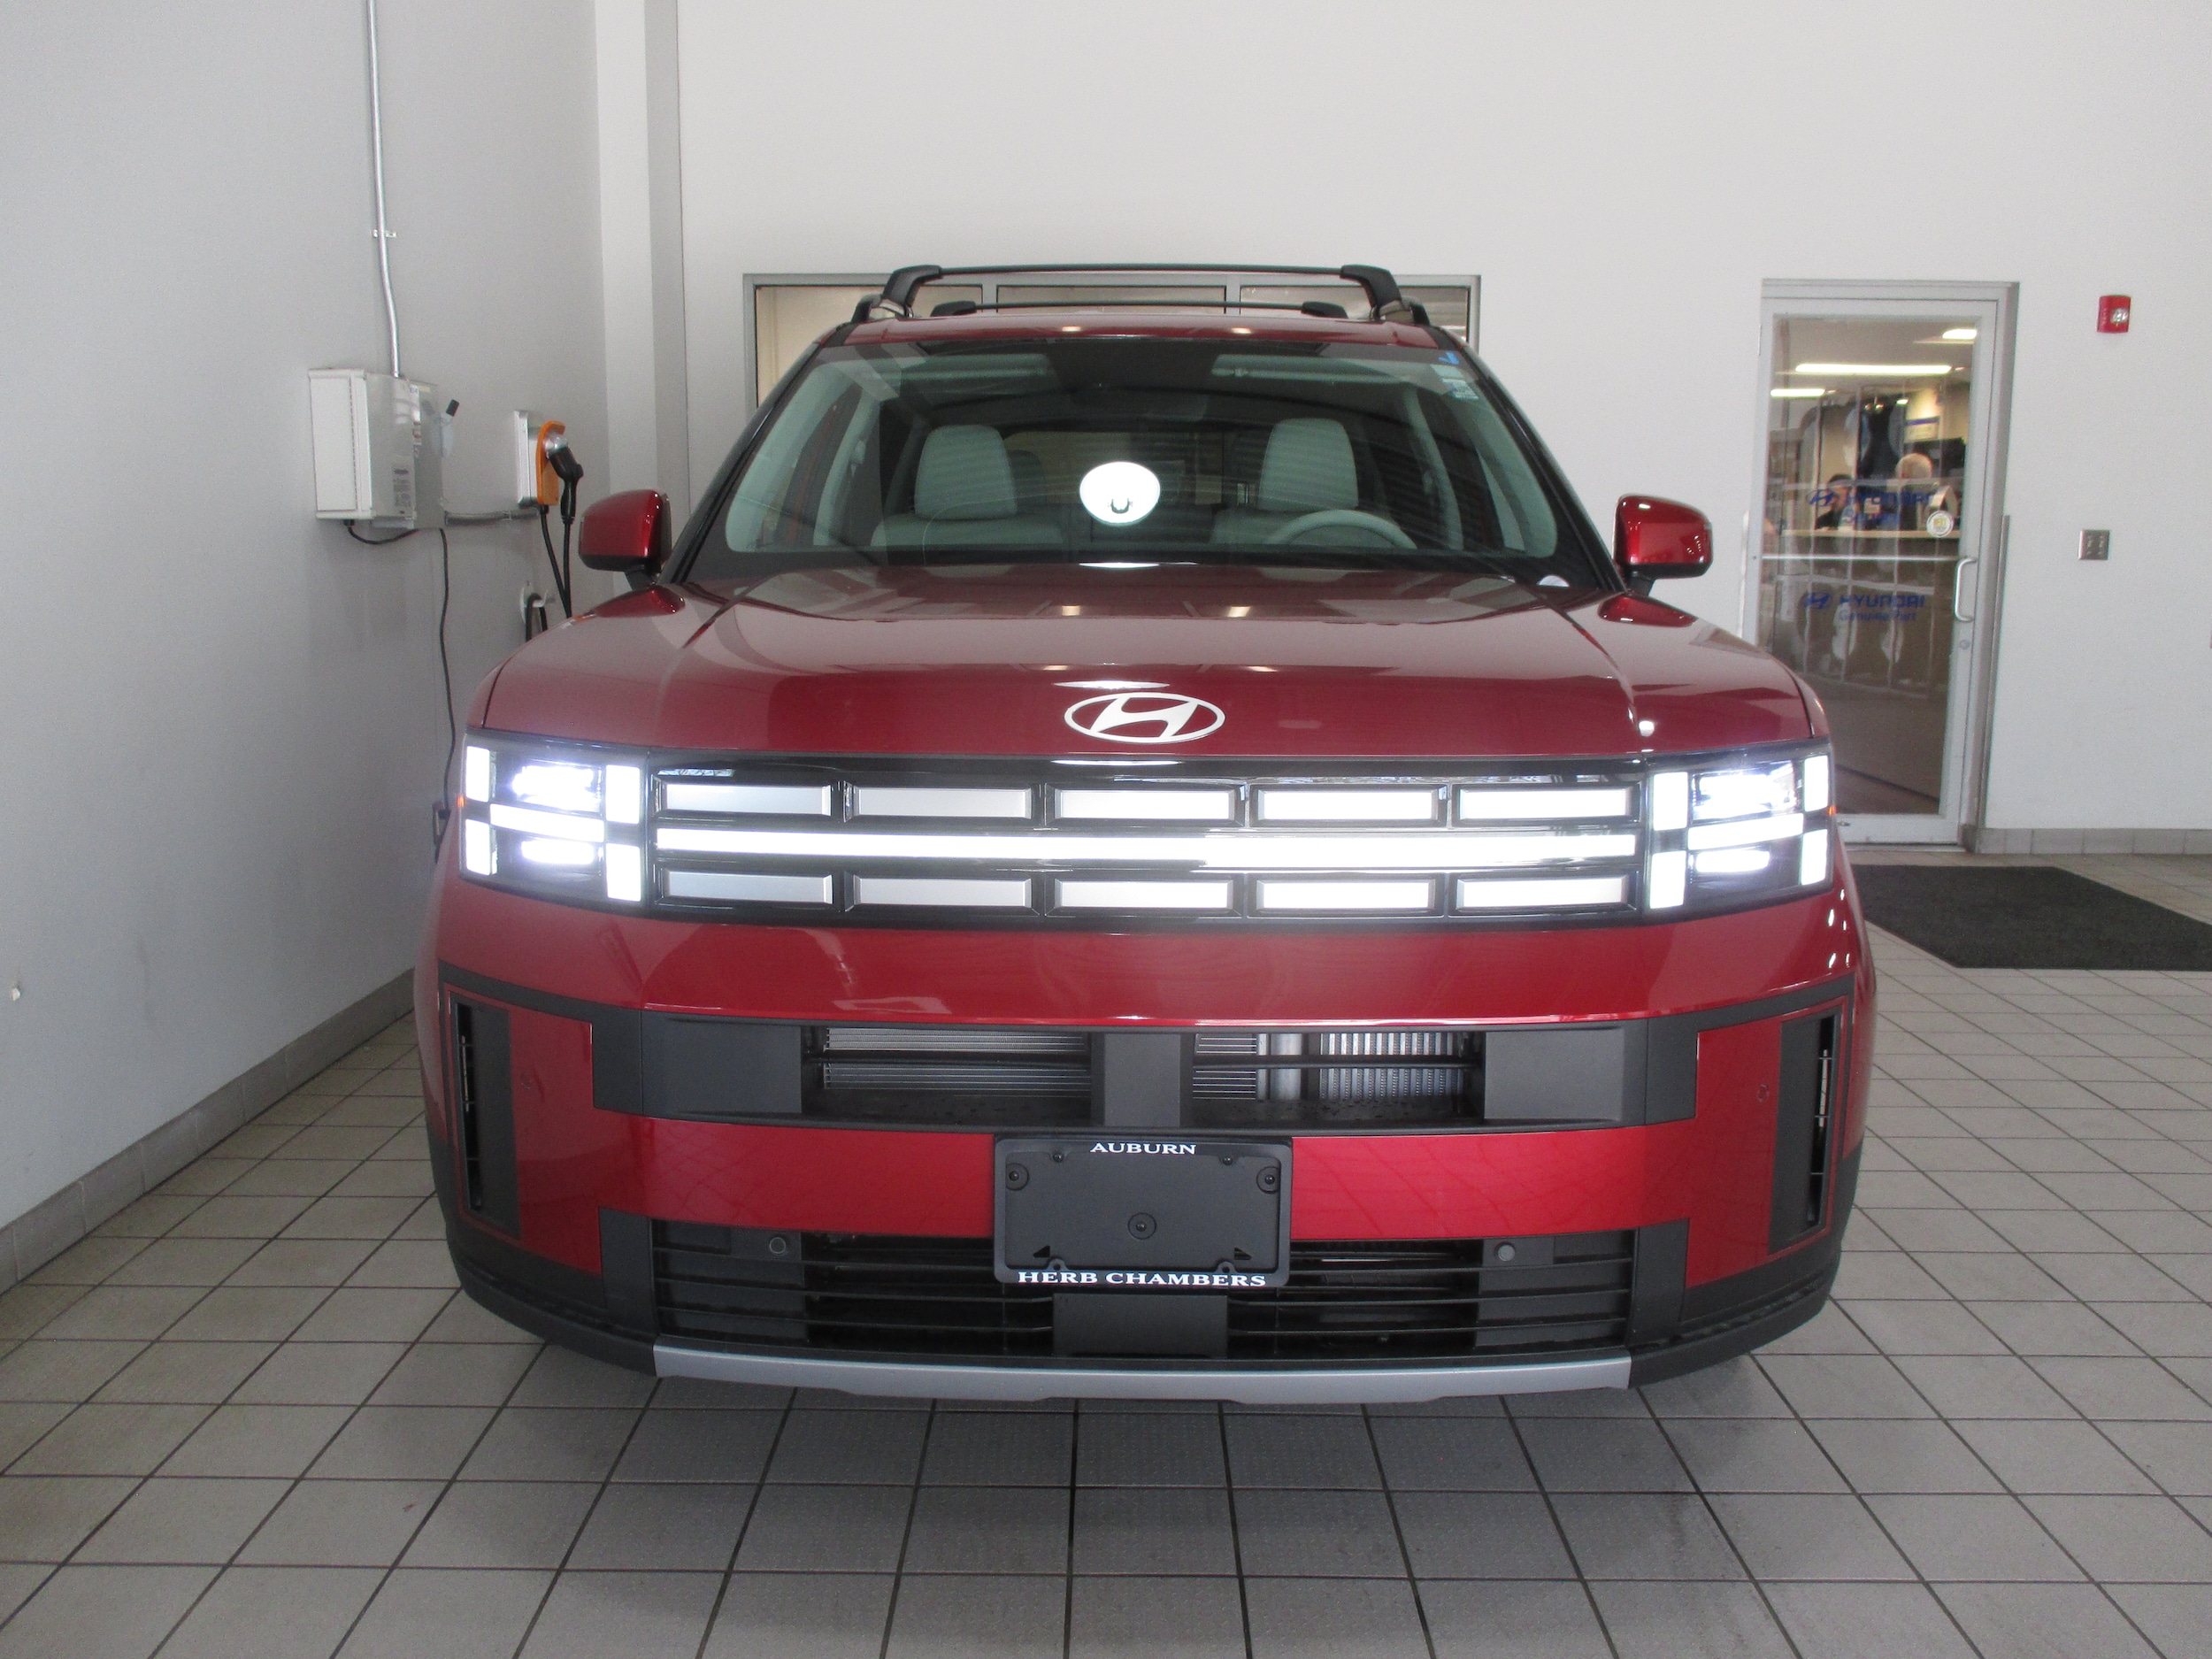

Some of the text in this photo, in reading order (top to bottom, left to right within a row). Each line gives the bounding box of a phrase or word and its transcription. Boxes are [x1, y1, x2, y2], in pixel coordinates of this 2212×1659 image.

[1839, 594, 1926, 608] HYUNDAI
[1090, 1142, 1197, 1156] AUBURN
[1018, 1271, 1267, 1286] HERB CHAMBERS
